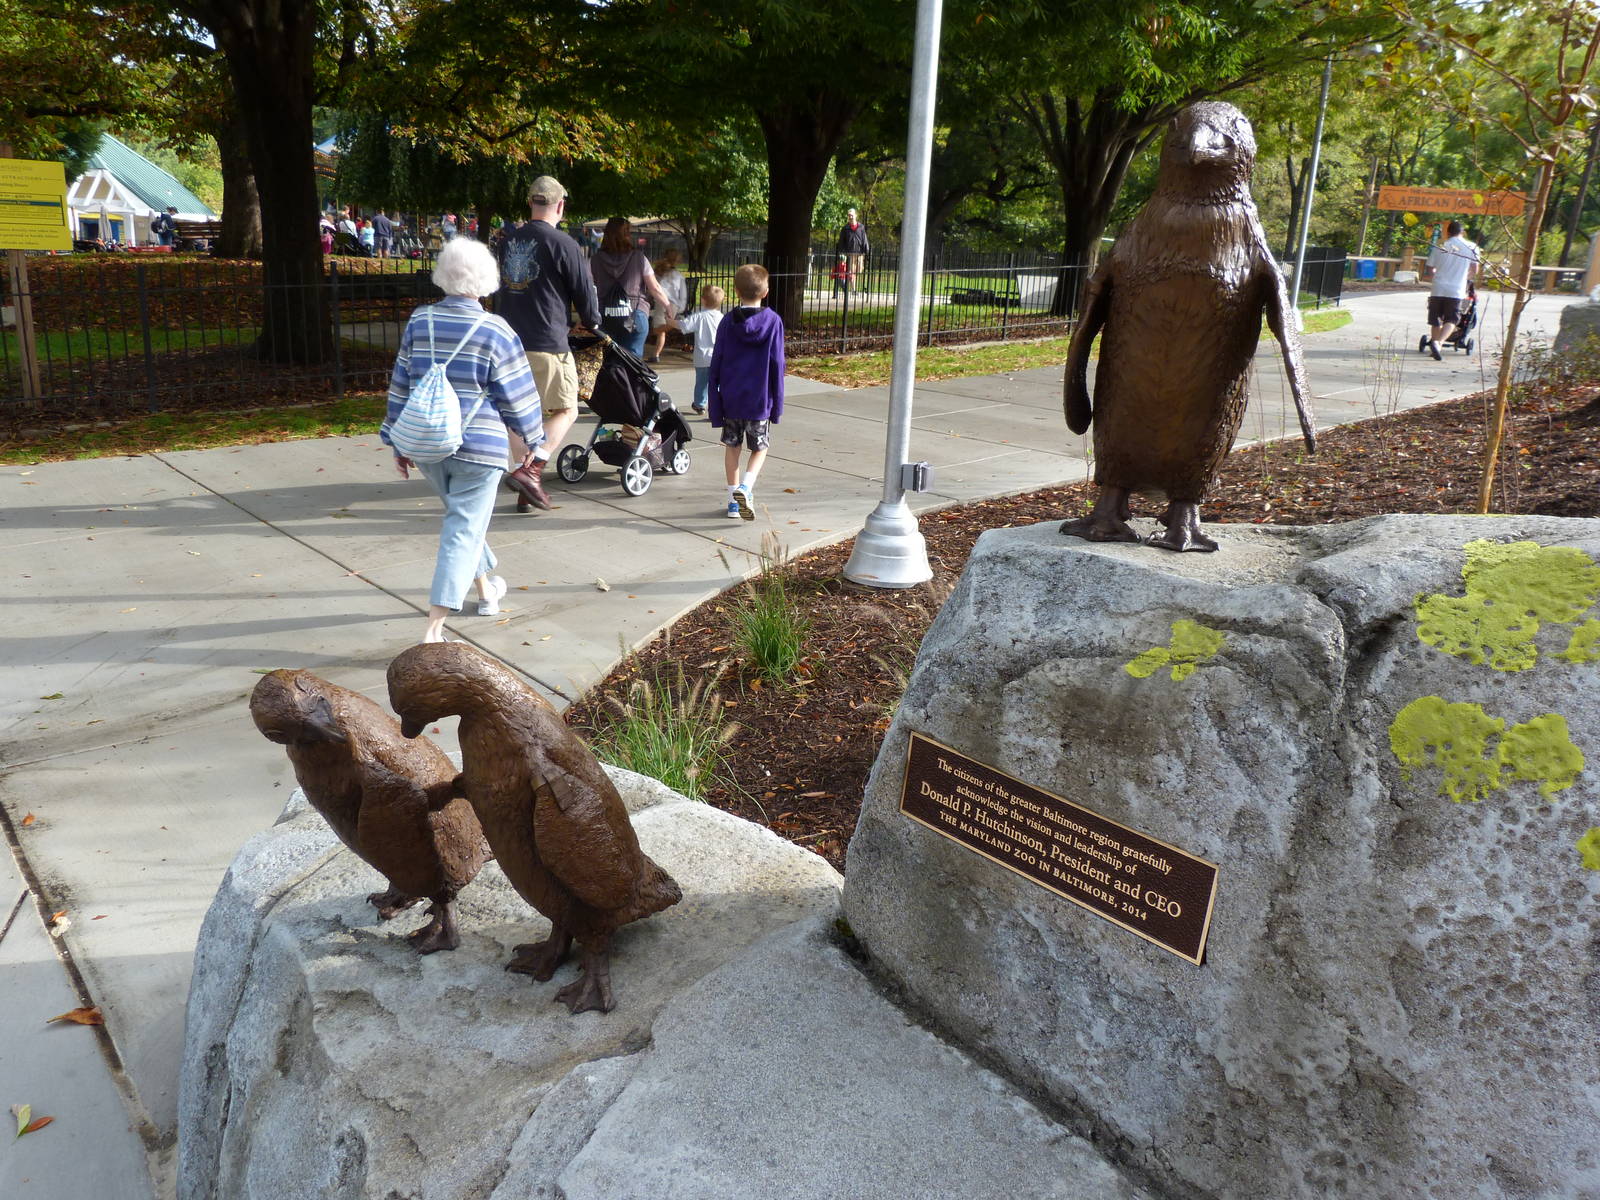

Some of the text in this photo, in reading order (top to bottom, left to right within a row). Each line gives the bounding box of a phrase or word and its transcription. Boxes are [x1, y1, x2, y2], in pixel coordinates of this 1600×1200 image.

[1399, 195, 1505, 210] AFRICAN JOUNEY
[920, 780, 1182, 918] Donald P. Hutchinson, President and CEO
[937, 757, 1172, 875] The citizens of the greater Baltimore region gratefully
[939, 810, 1148, 921] THE MARYLAND ZOO IN BALTIMORE, 2014
[956, 784, 1138, 876] acknowledge the vision and leadership of
